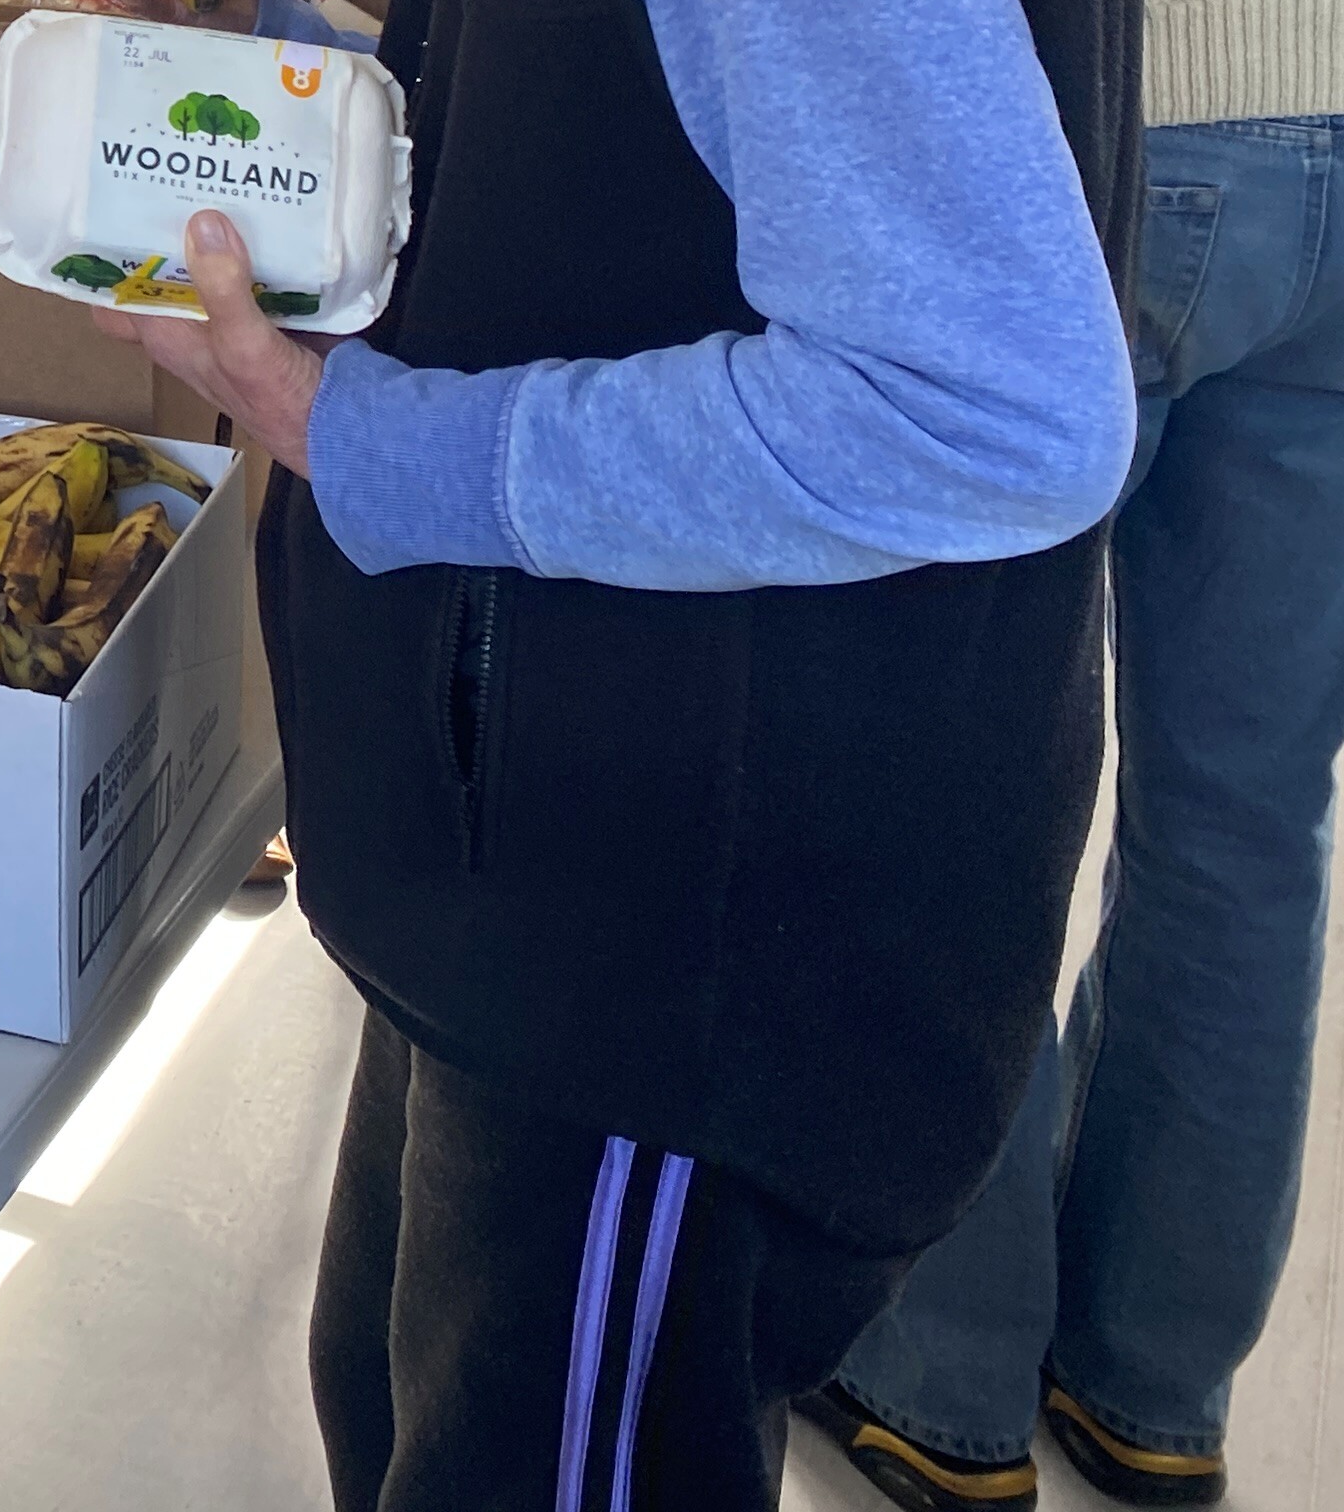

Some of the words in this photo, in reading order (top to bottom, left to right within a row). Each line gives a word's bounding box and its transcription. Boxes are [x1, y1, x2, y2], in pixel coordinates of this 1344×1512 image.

[124, 46, 139, 58] 22
[148, 50, 172, 63] JUL
[102, 141, 318, 195] WOODLAND
[114, 170, 138, 181] SIX
[150, 175, 186, 188] FREE
[197, 183, 250, 198] RANGE
[261, 192, 302, 206] EGGS
